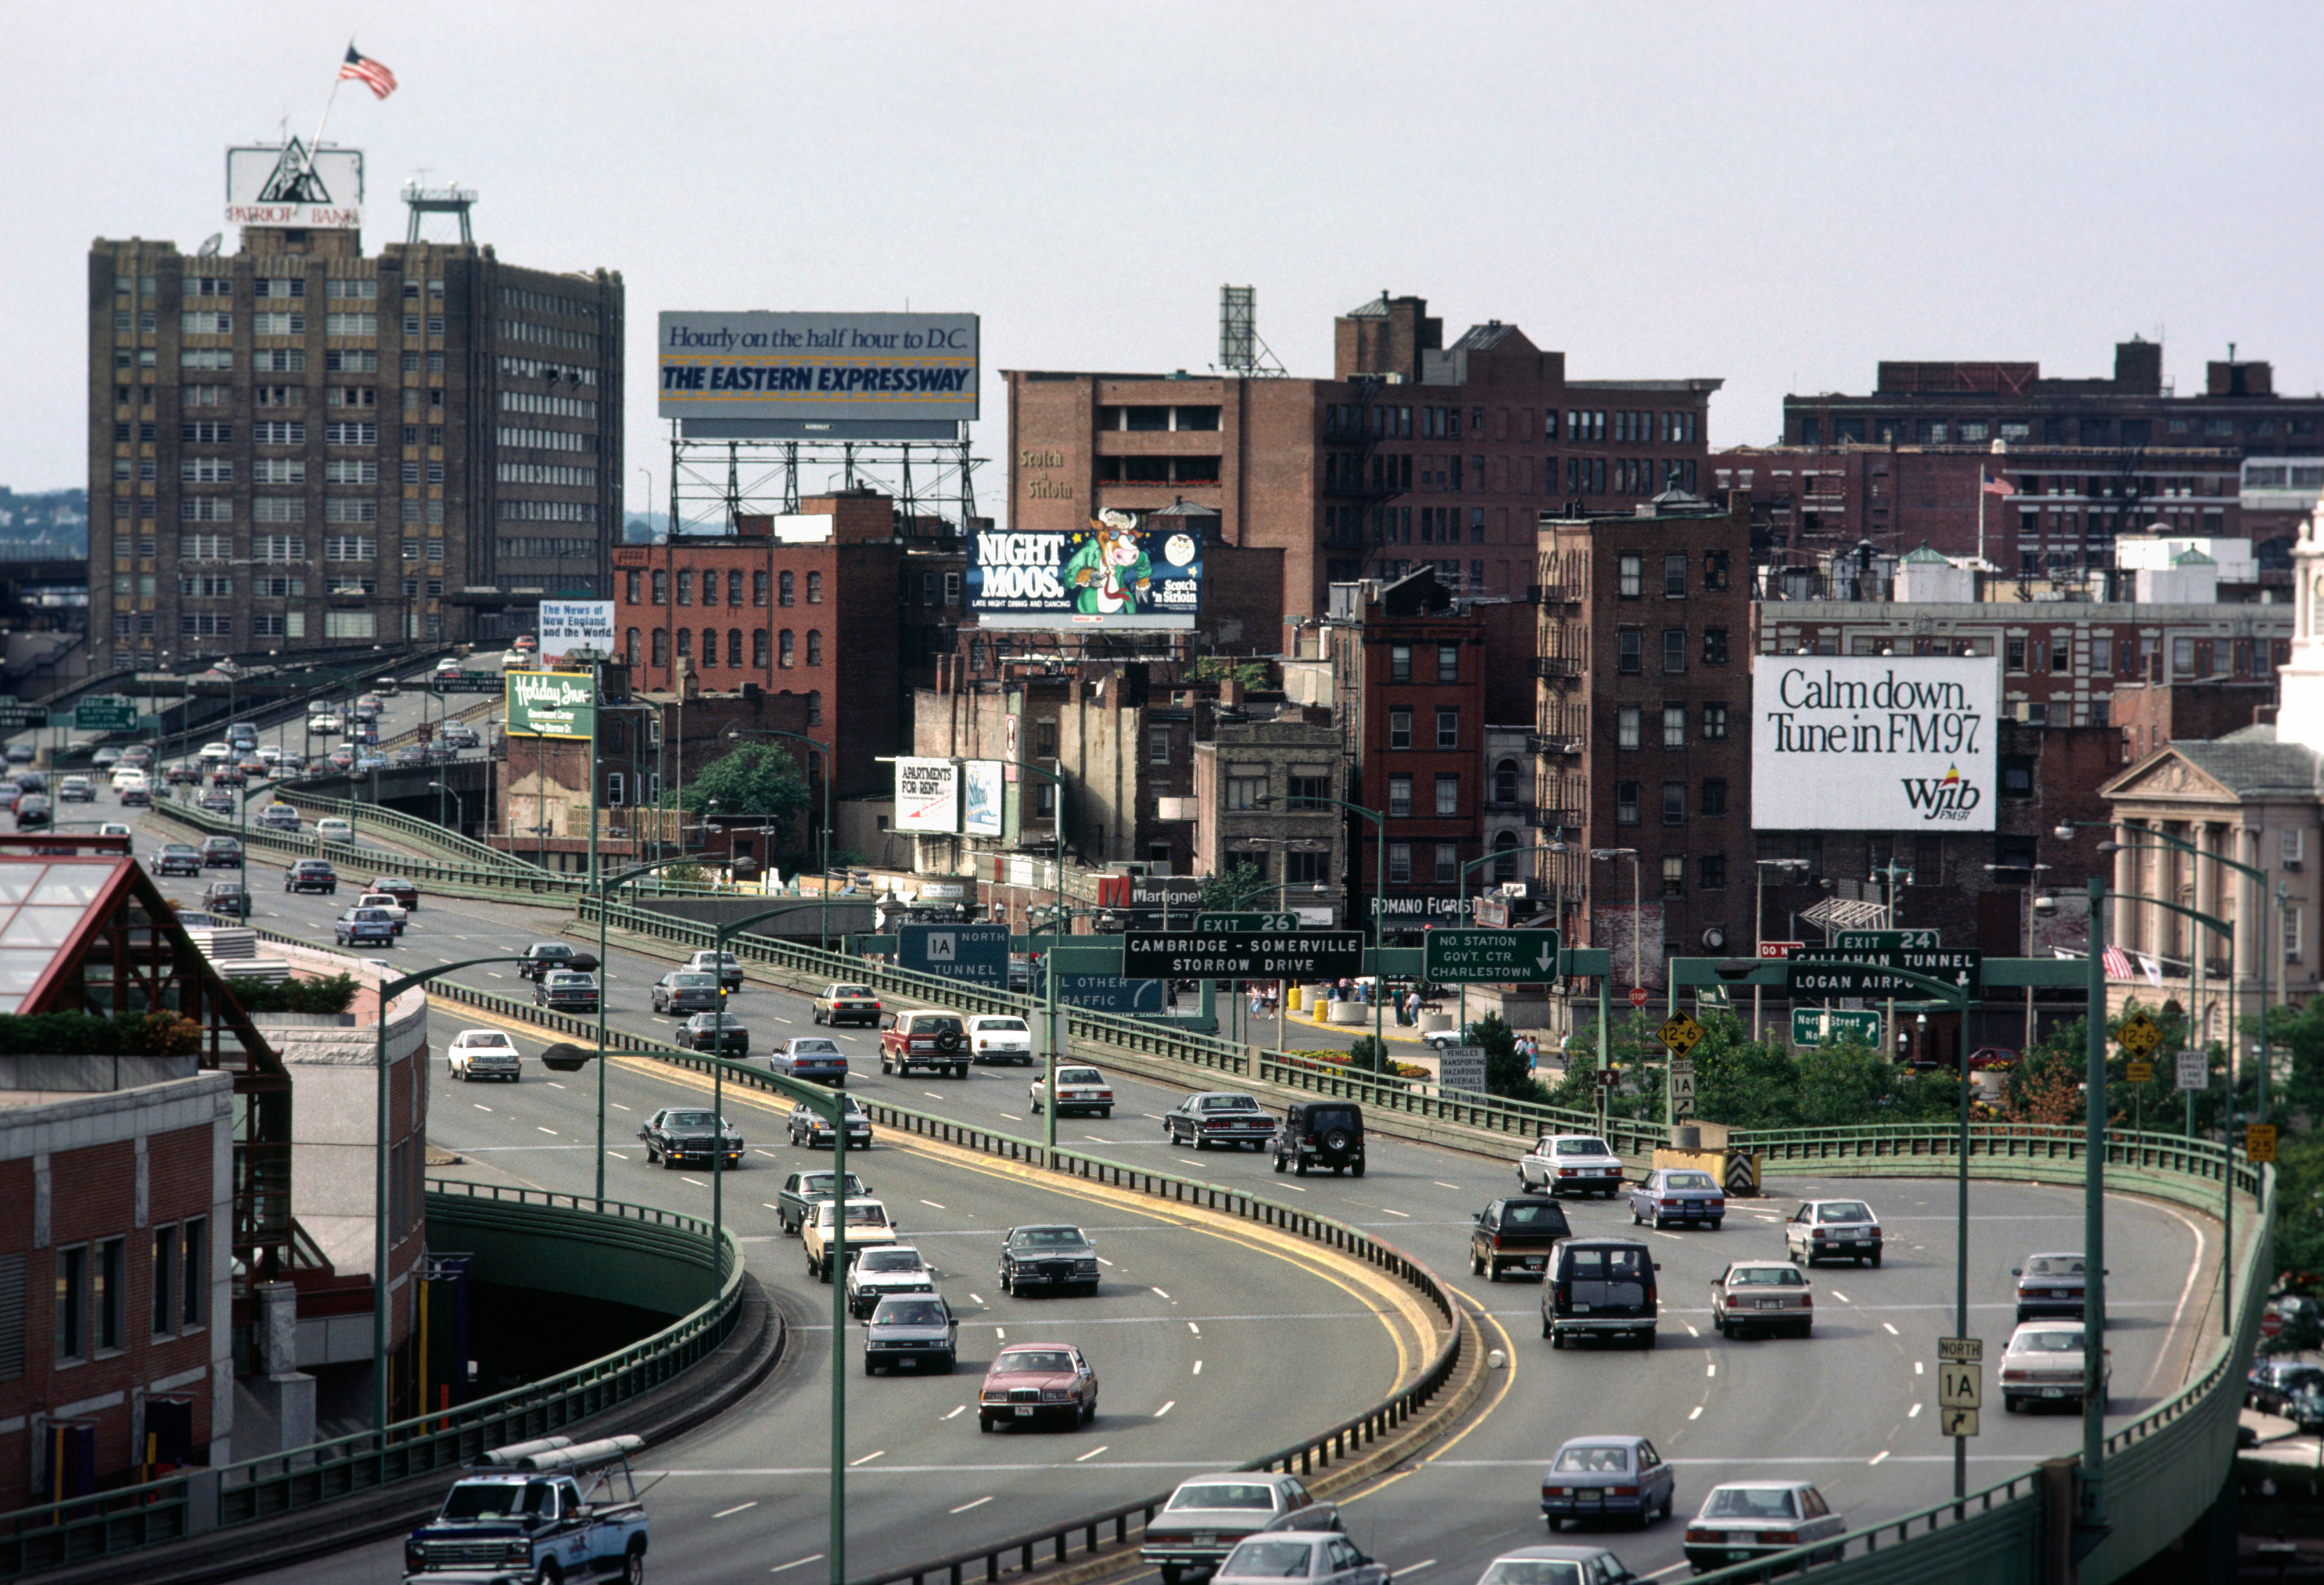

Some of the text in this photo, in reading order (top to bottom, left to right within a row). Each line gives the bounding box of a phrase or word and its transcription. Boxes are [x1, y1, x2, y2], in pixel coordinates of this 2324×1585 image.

[228, 206, 359, 224] PATRIOT BANK
[669, 326, 969, 352] Hourly on the half hour to D.C.
[663, 366, 970, 392] THE EASTERN EXPRESSWAY
[1020, 449, 1063, 467] Scotch
[1027, 481, 1073, 499] Sirloin
[977, 533, 1065, 566] NIGHT
[981, 566, 1064, 598] MOOS.
[1165, 579, 1197, 591] Scotch
[1163, 590, 1197, 603] Sirloin
[543, 605, 603, 615] The News of
[543, 616, 606, 627] New England
[543, 627, 614, 638] and the World.
[515, 676, 587, 706] Holiday Inn
[1780, 668, 1972, 711] Calm down.
[365, 734, 377, 744] 93
[1768, 713, 1847, 753] Tune
[1852, 714, 1882, 752] in
[1887, 713, 1941, 753] FM
[902, 766, 952, 781] APARTMENTS
[902, 780, 916, 794] FOR
[1371, 897, 1423, 916] ROMANO
[1427, 897, 1477, 915] FLORIST
[1204, 915, 1290, 931] EXIT 26
[962, 932, 1005, 942] NORTH
[1440, 937, 1517, 946] NO. STATION
[1844, 932, 1931, 949] EXIT 24
[931, 938, 951, 953] 1A
[1131, 939, 1228, 952] CAMBRIDGE
[1250, 939, 1357, 952] SOMERVILLE
[1762, 945, 1778, 955] DO
[1486, 952, 1514, 962] CTR.
[1904, 954, 1974, 967] TUNNEL
[934, 964, 997, 976] TUNNEL
[1172, 959, 1315, 971] STORROW DRIVE
[1431, 967, 1532, 977] CHARLESTOWN
[1041, 977, 1128, 988] AL OTHER
[1796, 976, 1852, 988] LOGAN
[1061, 995, 1116, 1006] RAFFIC
[1630, 992, 1648, 1001] STOP
[1830, 1016, 1860, 1027] Street
[1670, 1061, 1695, 1070] NORTH
[1674, 1078, 1691, 1092] 1A
[2251, 1141, 2272, 1153] 25
[1941, 1343, 1979, 1356] NORTH
[1947, 1374, 1974, 1397] 1A
